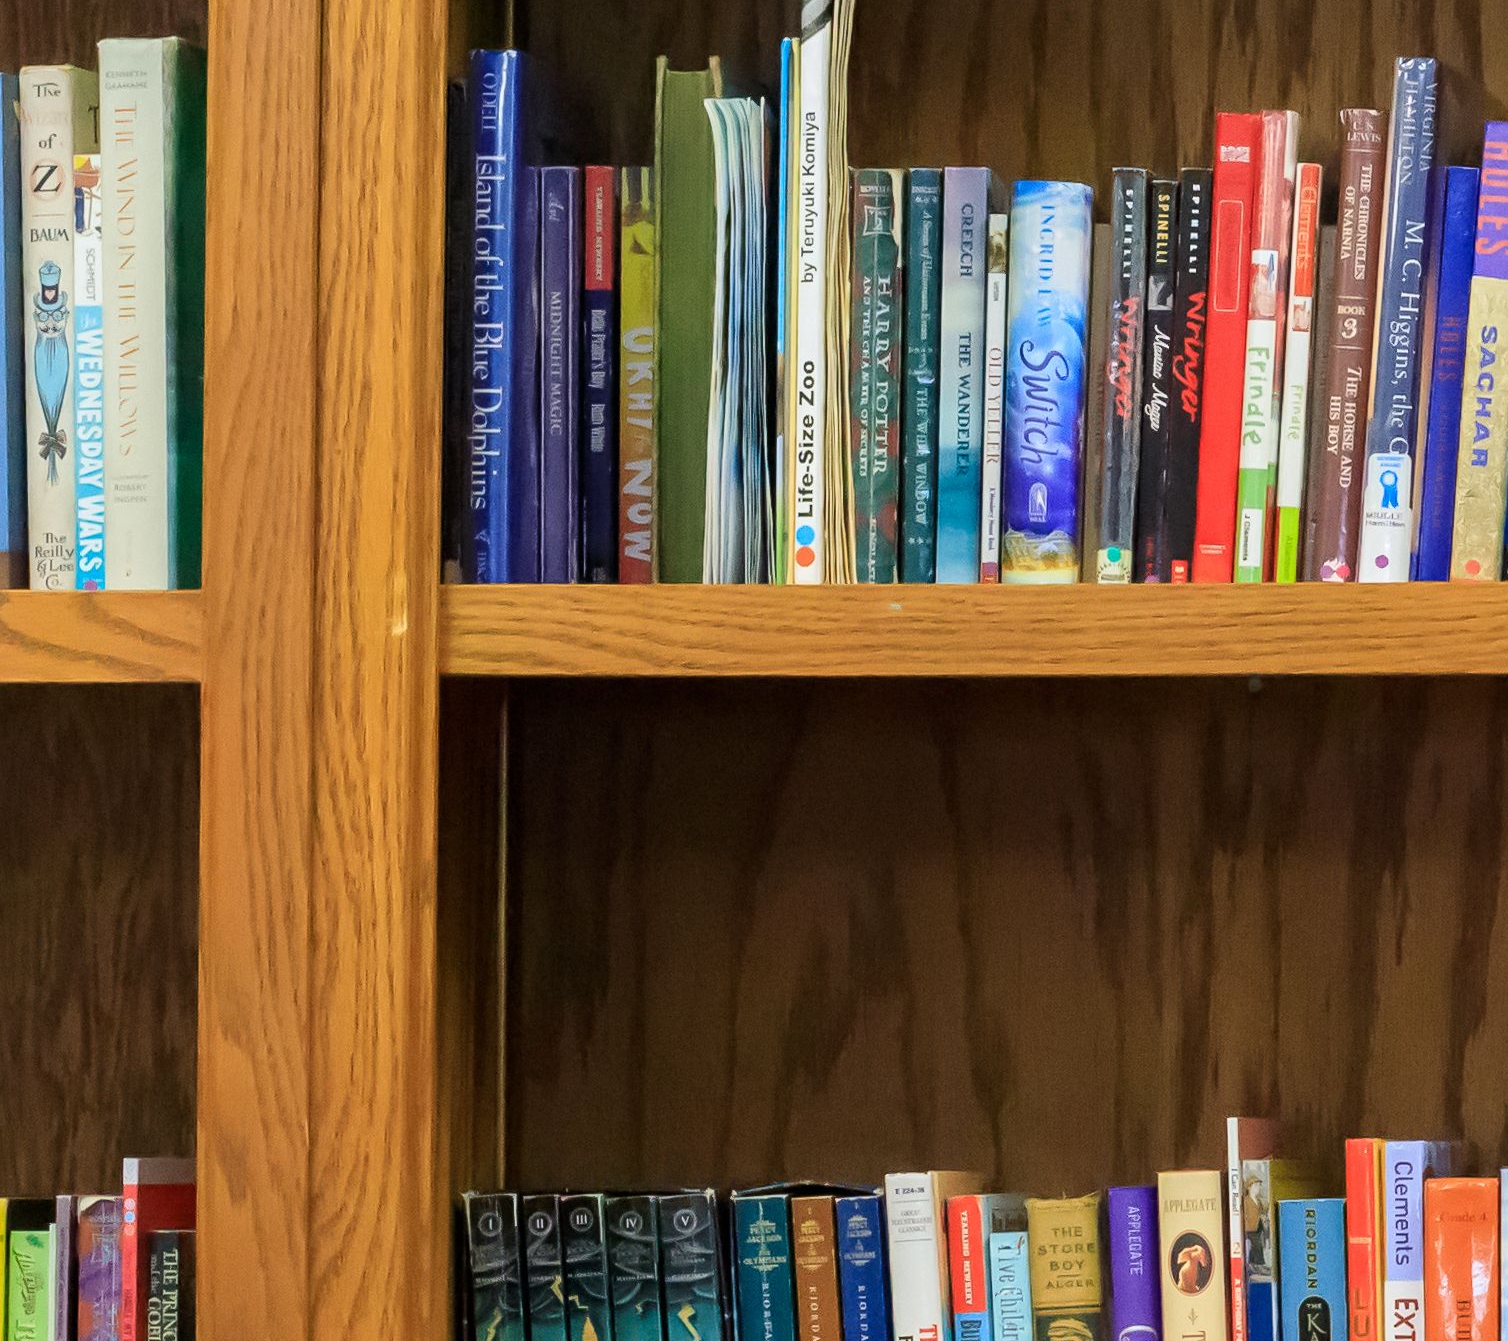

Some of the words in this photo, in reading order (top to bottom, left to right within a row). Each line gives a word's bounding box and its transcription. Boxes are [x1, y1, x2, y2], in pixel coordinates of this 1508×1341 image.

[473, 153, 507, 231] Island
[474, 238, 502, 267] of
[959, 203, 974, 277] CREECH
[1401, 259, 1423, 283] C.
[1404, 220, 1425, 251] M.
[473, 274, 503, 315] the
[872, 276, 891, 372] HARRY
[472, 322, 503, 380] Blue
[957, 332, 973, 368] THE
[1388, 292, 1420, 386] Higgins,
[798, 361, 817, 406] Zoo
[1018, 340, 1069, 466] Switch
[1389, 393, 1410, 429] the
[1470, 325, 1498, 468] SACHAR
[466, 387, 502, 509] Dolphins
[870, 381, 890, 476] POTTER
[956, 374, 972, 476] WANDERER
[795, 414, 818, 518] Life-Size
[1394, 1161, 1414, 1266] Clements
